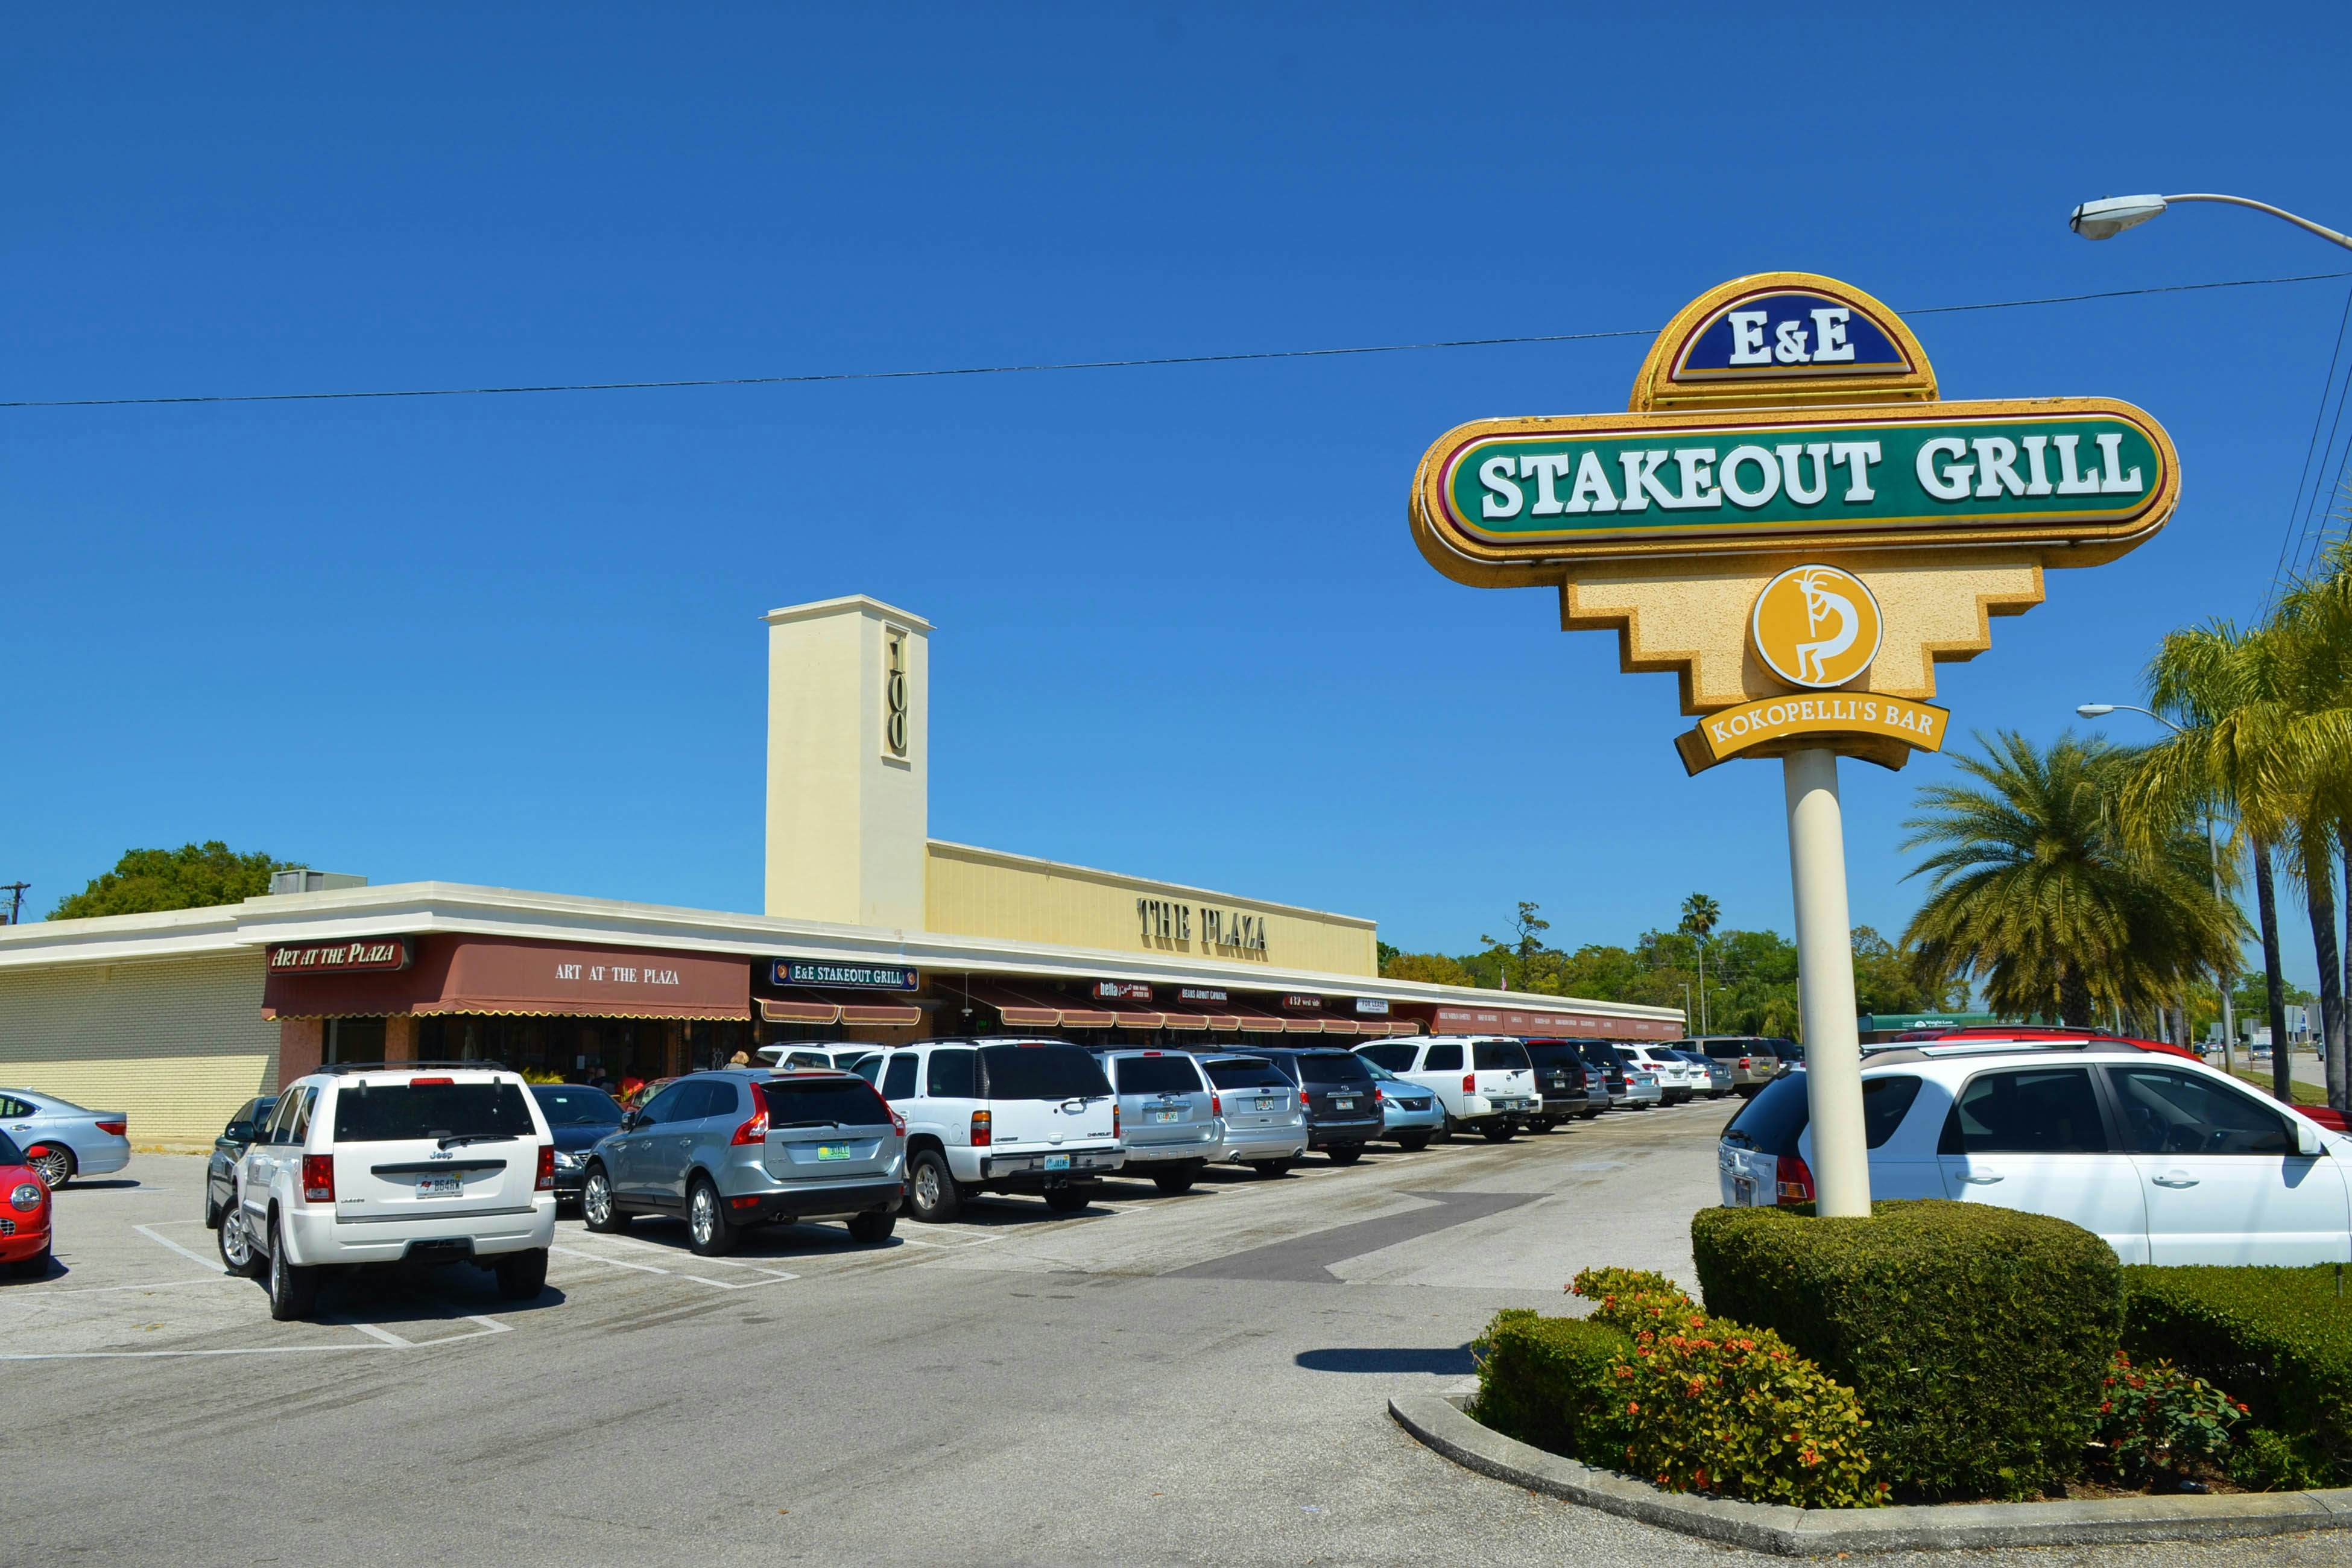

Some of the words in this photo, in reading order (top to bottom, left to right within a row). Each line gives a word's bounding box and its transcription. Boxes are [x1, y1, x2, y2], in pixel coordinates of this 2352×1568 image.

[1728, 308, 1855, 365] E&E
[1479, 440, 1882, 518] STAKEOUT
[1916, 433, 2143, 500] GRILL
[1710, 700, 1877, 744] KOKOPELLI'S
[1885, 705, 1933, 736] BAR
[1137, 897, 1191, 941] THE
[1201, 908, 1269, 950] PLAZA
[271, 947, 300, 967] ART
[321, 947, 347, 964] THE
[348, 943, 394, 963] PLAZA
[555, 964, 582, 979] ART
[589, 966, 605, 981] AT
[612, 967, 637, 982] THE
[643, 969, 679, 985] PLAZA
[794, 966, 814, 980] E&E
[817, 967, 871, 983] STAKEOUT
[874, 970, 902, 984] GRILL
[1100, 982, 1118, 996] bella
[429, 1151, 454, 1160] Jeep
